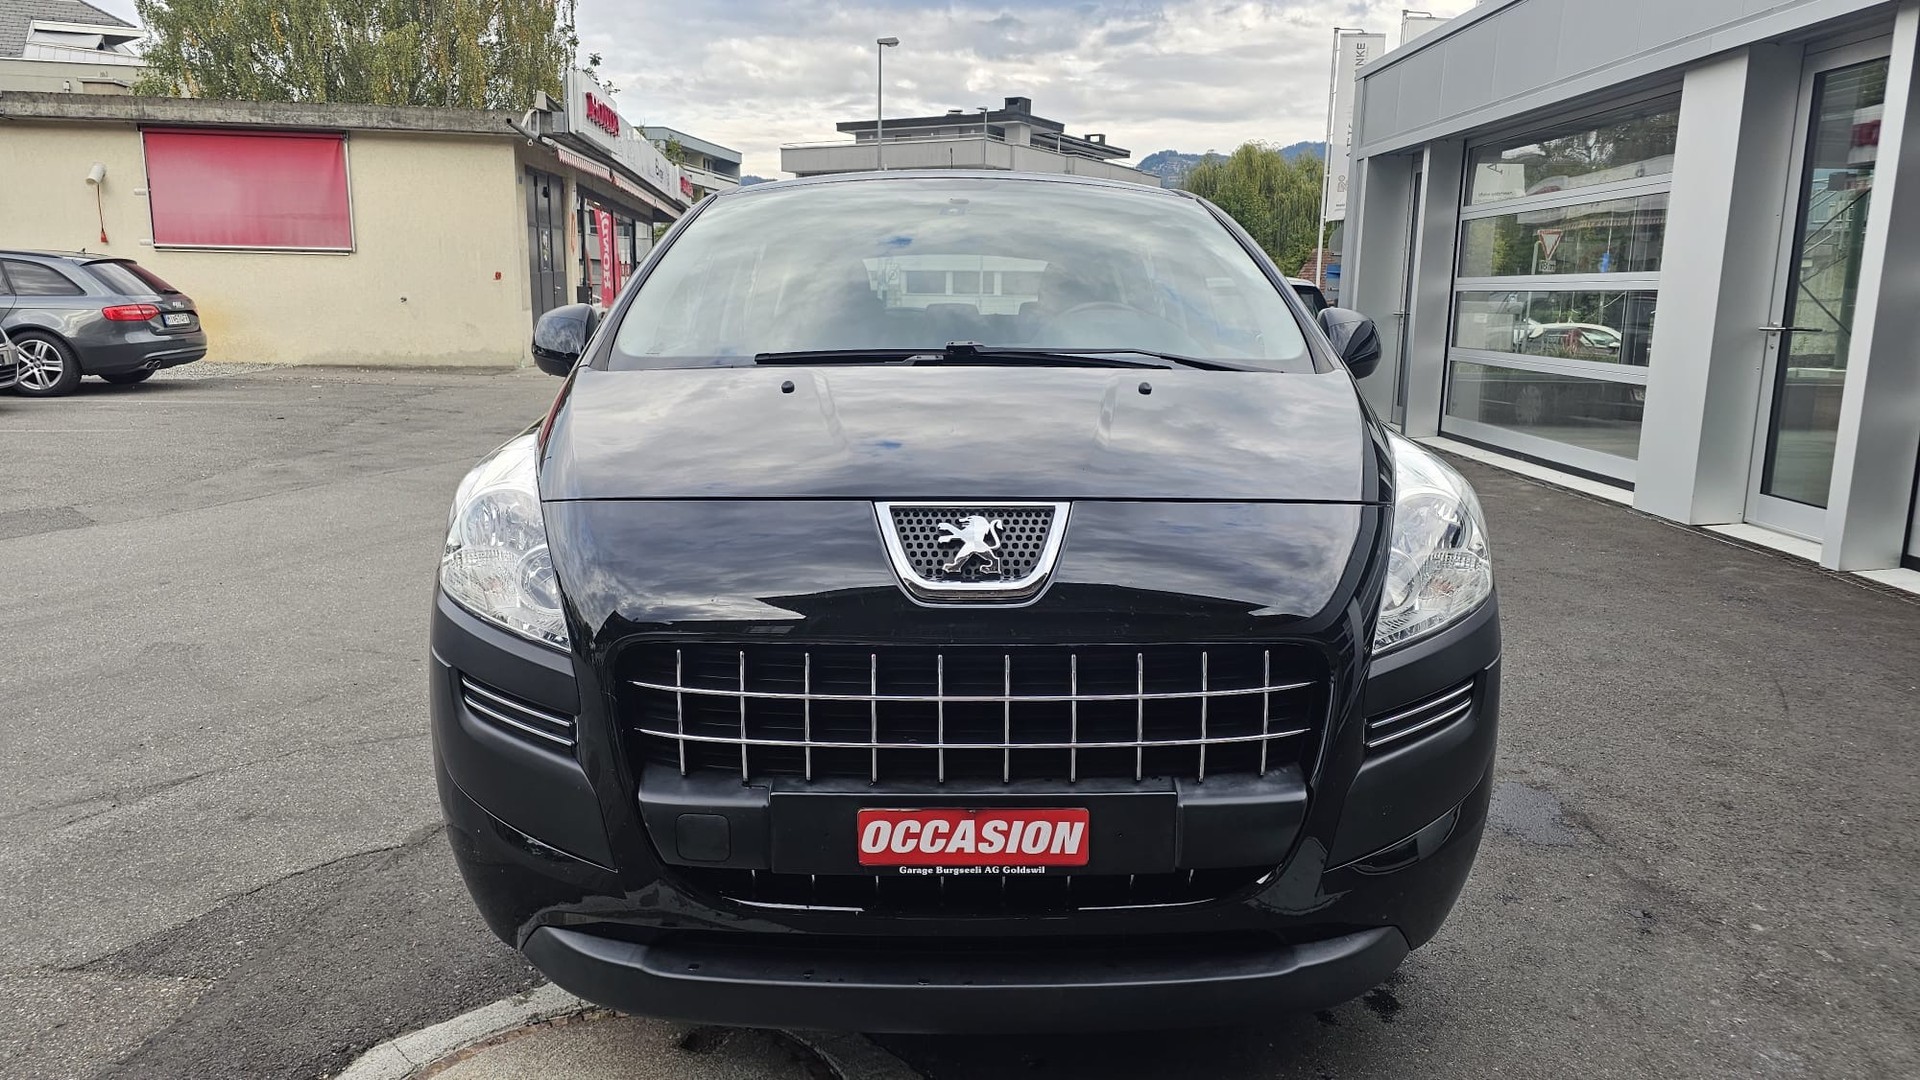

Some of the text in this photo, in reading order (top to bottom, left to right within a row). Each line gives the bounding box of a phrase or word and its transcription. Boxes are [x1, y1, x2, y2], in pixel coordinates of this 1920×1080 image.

[861, 819, 1085, 854] OCCASION
[899, 866, 1045, 875] Garage Burgseeli AG Goldswil
